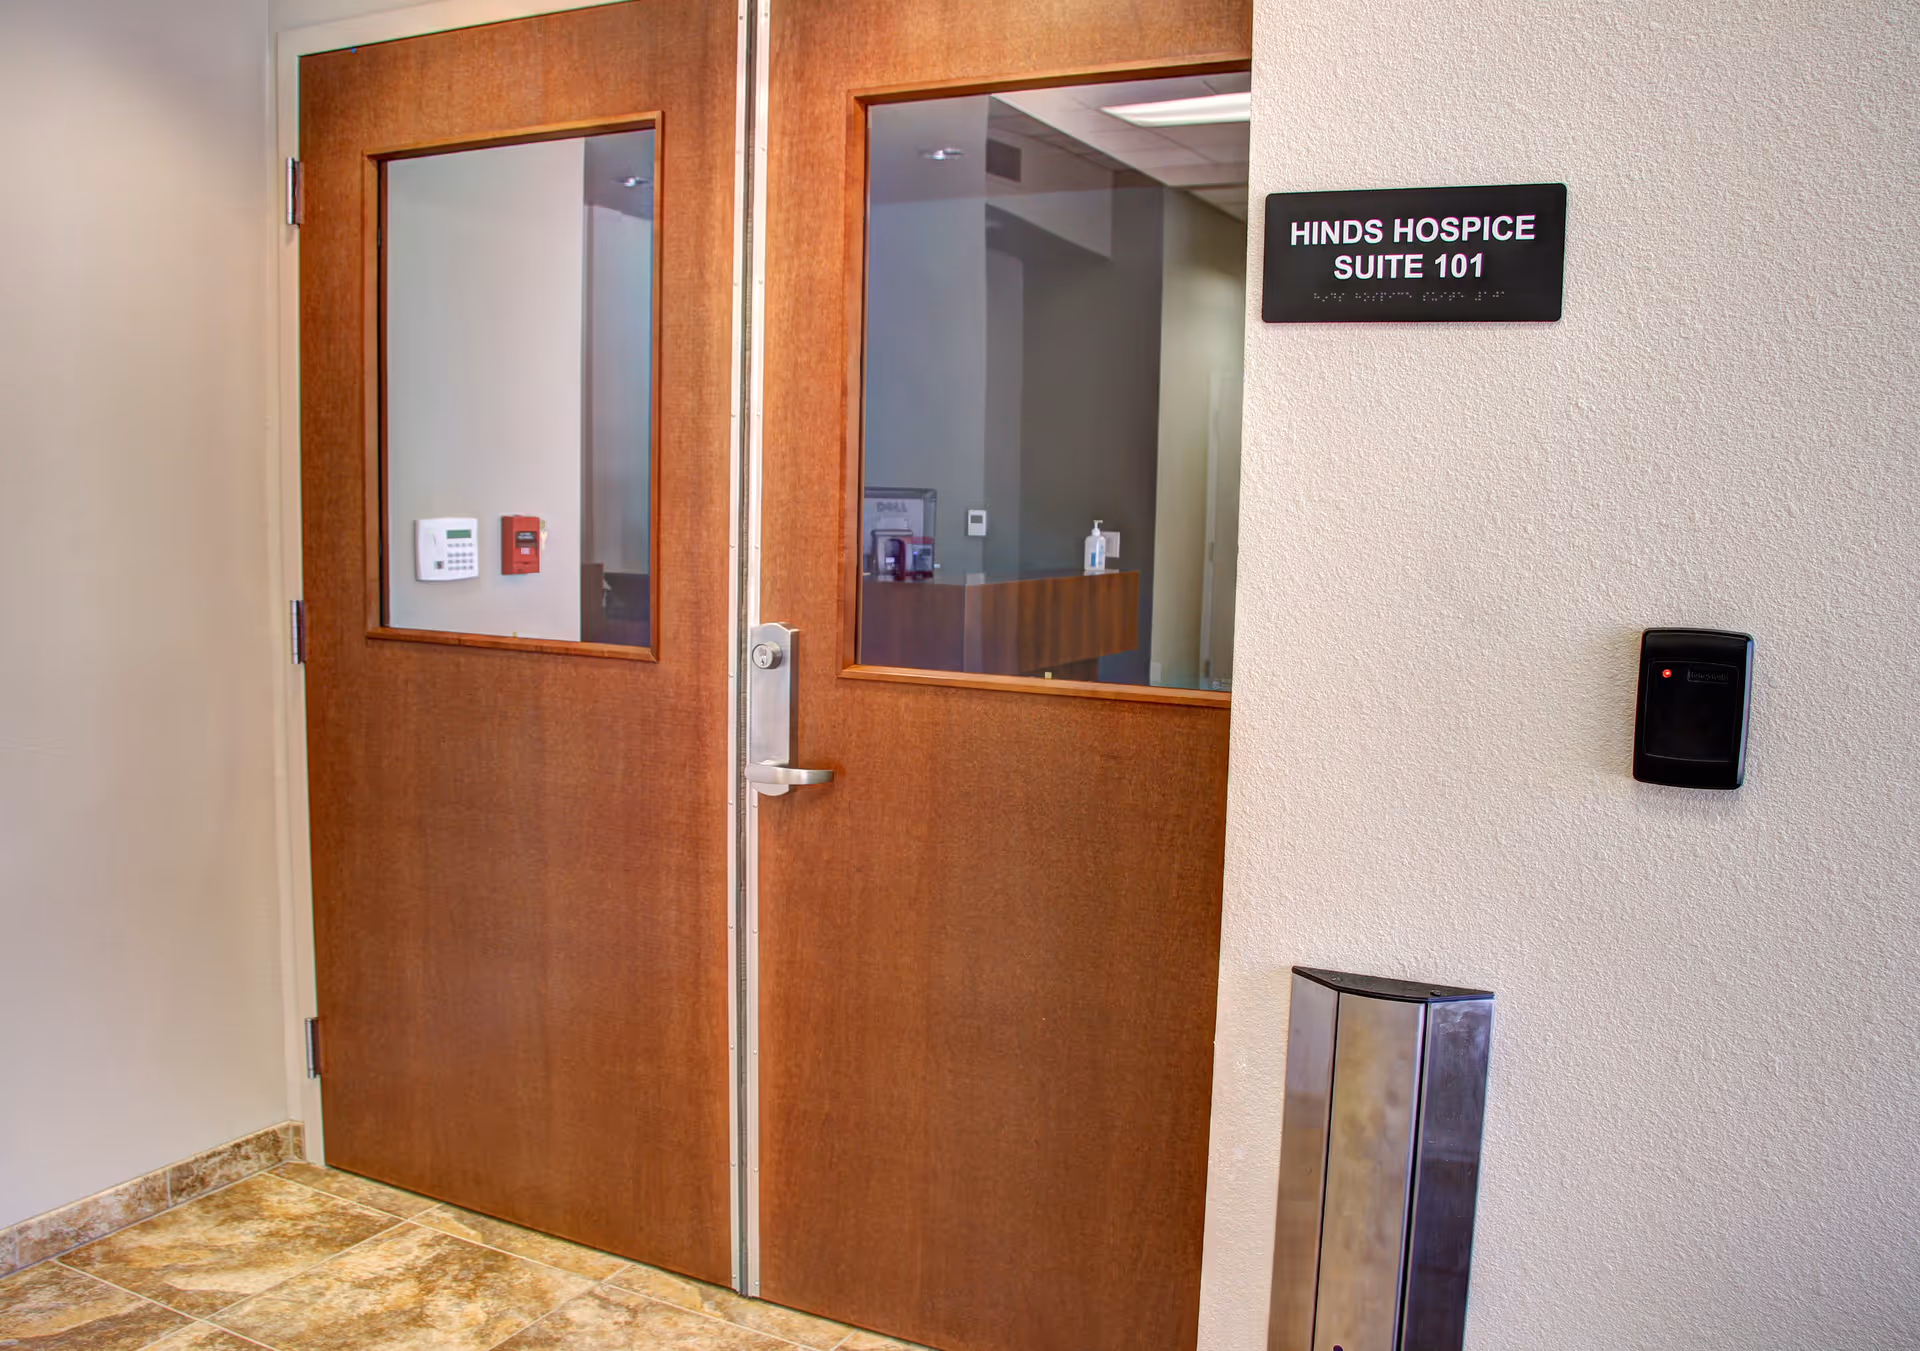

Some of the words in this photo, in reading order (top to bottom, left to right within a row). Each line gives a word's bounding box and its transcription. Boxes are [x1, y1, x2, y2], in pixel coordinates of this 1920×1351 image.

[1290, 220, 1384, 246] HINDS
[1393, 214, 1536, 243] HOSPICE
[1333, 253, 1424, 280] SUITE
[1434, 252, 1484, 278] 101
